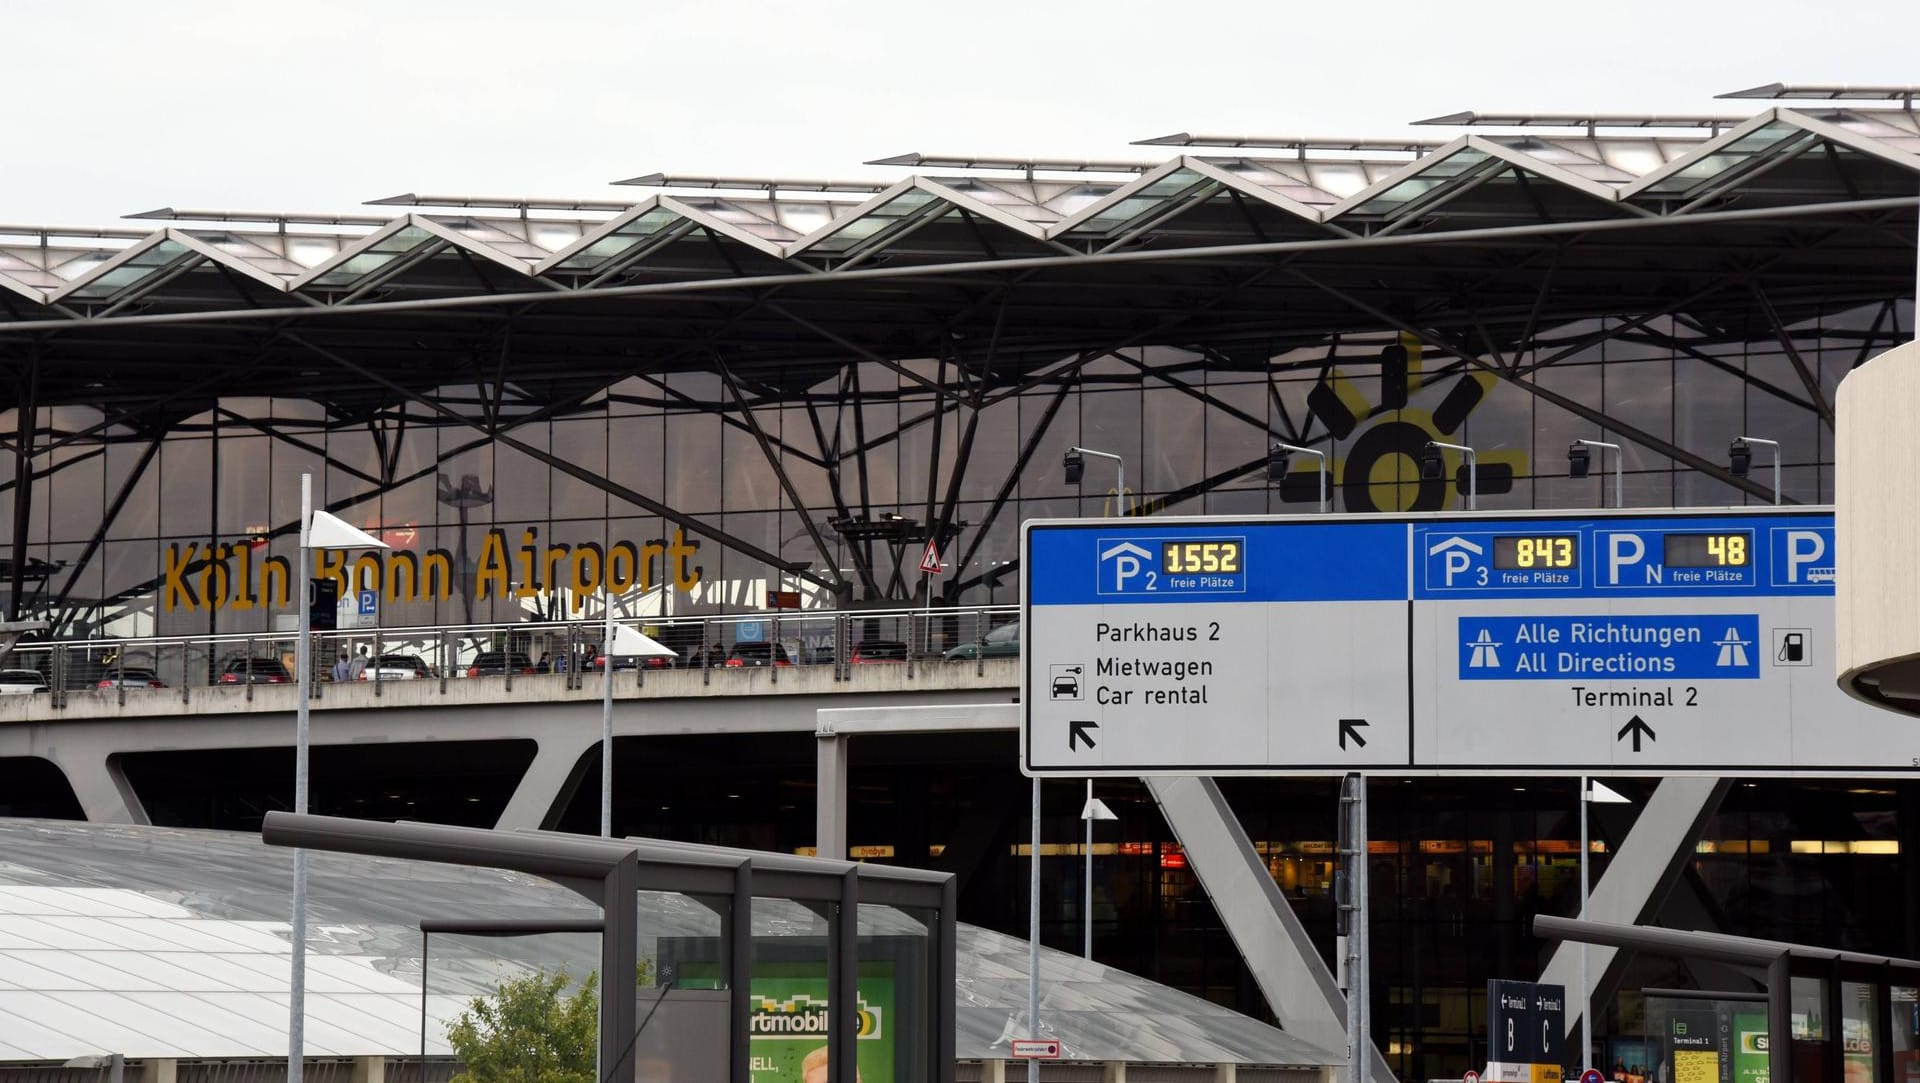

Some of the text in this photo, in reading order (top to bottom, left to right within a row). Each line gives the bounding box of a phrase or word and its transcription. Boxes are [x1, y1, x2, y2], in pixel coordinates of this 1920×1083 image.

[1167, 543, 1237, 573] 1552
[1517, 538, 1572, 567] 843
[1609, 533, 1662, 585] P N
[1707, 535, 1745, 566] 48
[1787, 530, 1825, 583] P
[165, 527, 703, 613] Köln Bonn Airport
[1116, 557, 1157, 591] P 2
[1446, 551, 1488, 586] P 3
[1502, 572, 1569, 584] freie Plätze
[1673, 569, 1743, 583] freie Plätze
[1170, 576, 1234, 588] freie Plätze
[362, 593, 371, 611] P
[1096, 622, 1221, 641] Parkhaus 2
[1516, 623, 1701, 648] Alle Richtungen
[1096, 657, 1213, 681] Mietwagen
[1516, 652, 1676, 673] All Directions
[1096, 685, 1208, 705] Car rental
[1572, 686, 1698, 707] Terminal 2
[1508, 996, 1523, 1010] Terminal
[1543, 998, 1558, 1011] Terminal
[1508, 1018, 1514, 1052] B
[1543, 1019, 1549, 1053] C
[1674, 1037, 1709, 1045] Terminal 1
